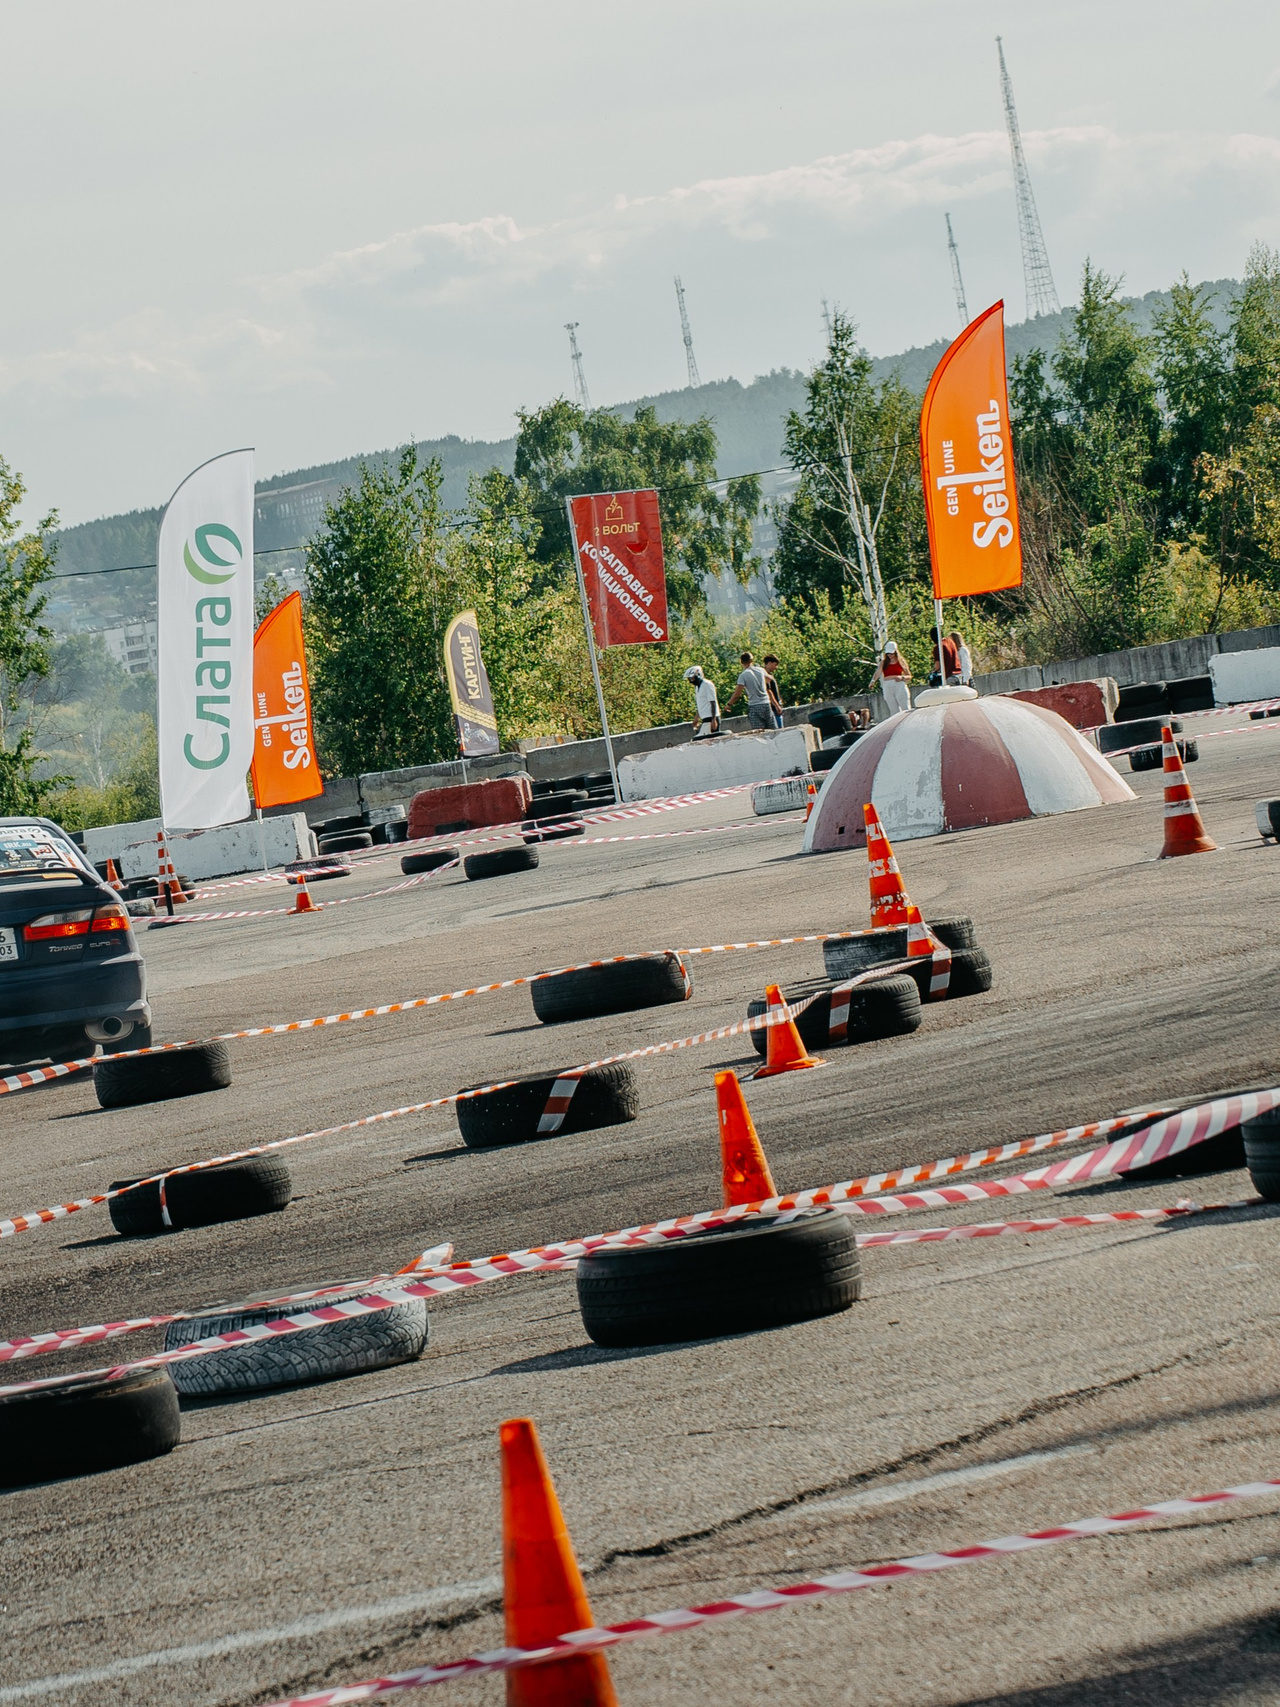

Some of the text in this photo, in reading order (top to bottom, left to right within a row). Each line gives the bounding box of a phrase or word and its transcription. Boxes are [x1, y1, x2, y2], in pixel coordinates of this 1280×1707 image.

[937, 399, 1014, 548] Seiken
[602, 522, 641, 535] ВОЛЬТ
[579, 540, 665, 640] КОИЦИОНЕРОВ
[599, 545, 654, 607] ЗАПРАВКА
[183, 595, 232, 770] Слата
[457, 631, 480, 700] КАРТИНГ
[255, 661, 311, 770] Seiken
[0, 945, 13, 956] 03
